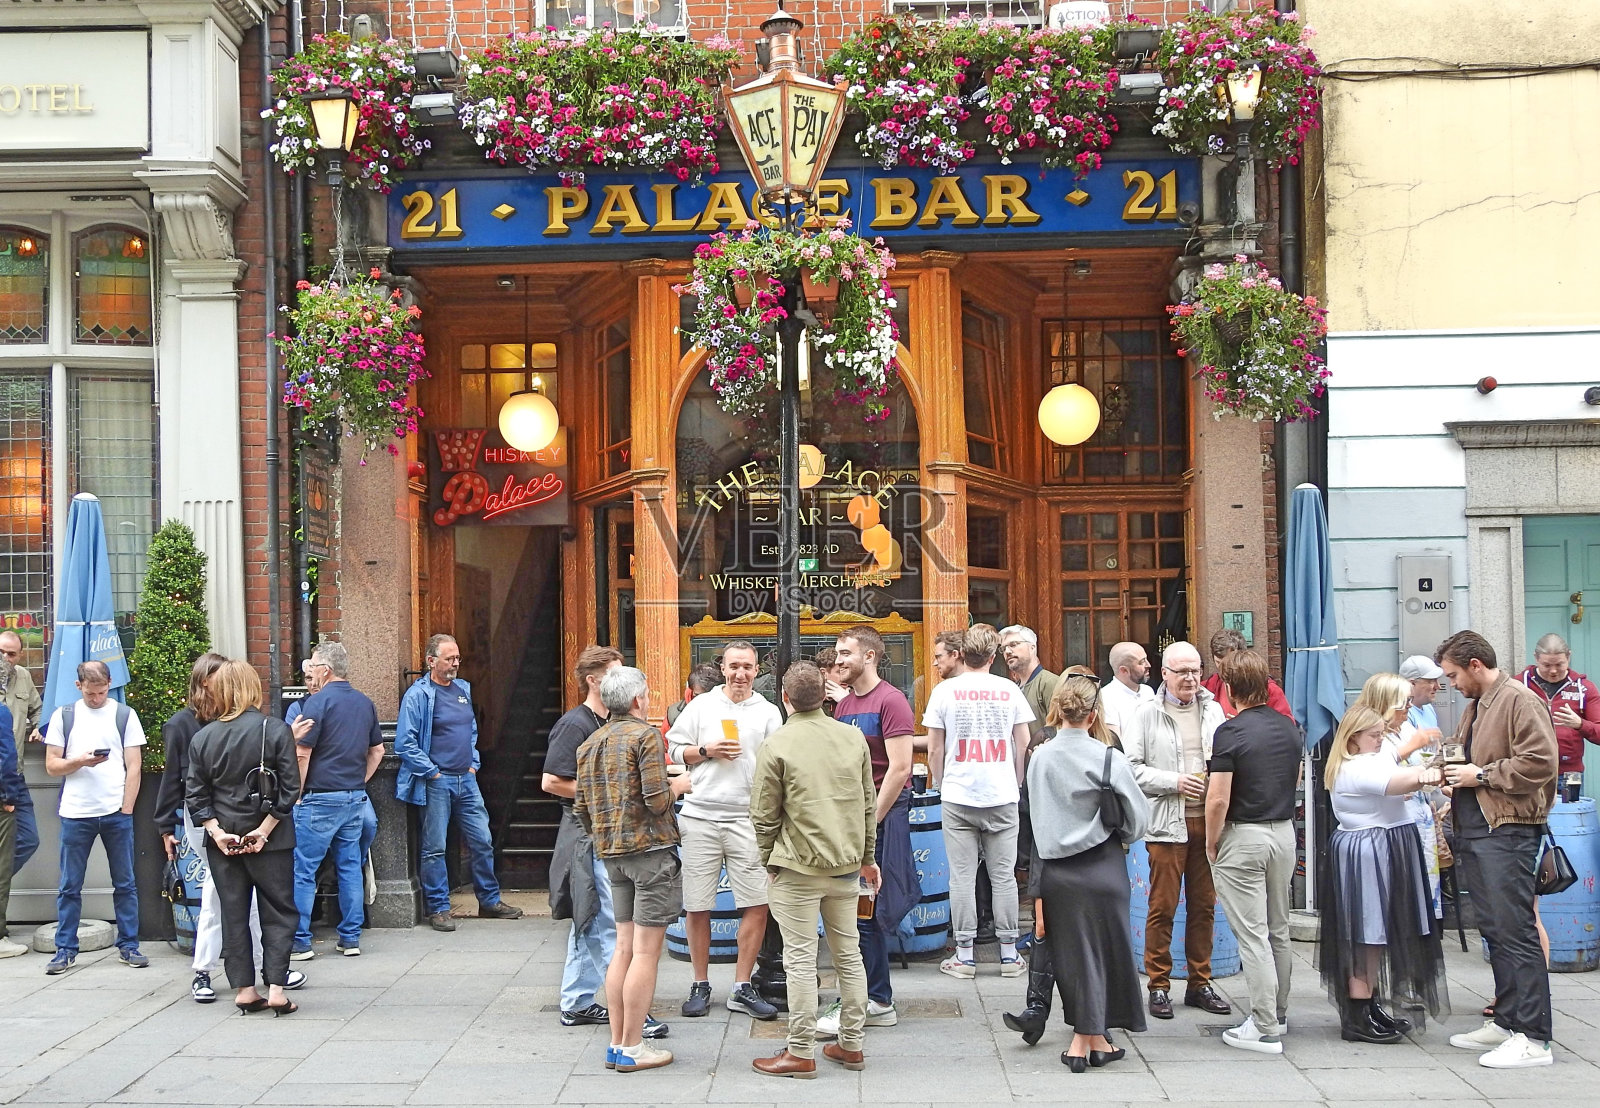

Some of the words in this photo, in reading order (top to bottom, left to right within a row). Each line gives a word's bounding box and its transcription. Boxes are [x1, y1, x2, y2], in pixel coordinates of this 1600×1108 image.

[1057, 10, 1106, 21] ACTION
[794, 93, 816, 107] THE
[747, 107, 780, 149] ACE
[763, 164, 781, 181] BAR
[401, 188, 463, 240] 21
[868, 175, 1041, 228] BAR
[1122, 169, 1180, 221] 21
[698, 460, 765, 513] THE
[776, 452, 899, 511] ALACE
[434, 471, 563, 526] Palace
[799, 543, 819, 555] 823
[822, 543, 840, 555] AD
[1422, 580, 1429, 589] 4
[1424, 601, 1447, 610] MCO
[953, 689, 1011, 701] WORLD
[955, 738, 1007, 763] JAM
[908, 808, 927, 822] 23
